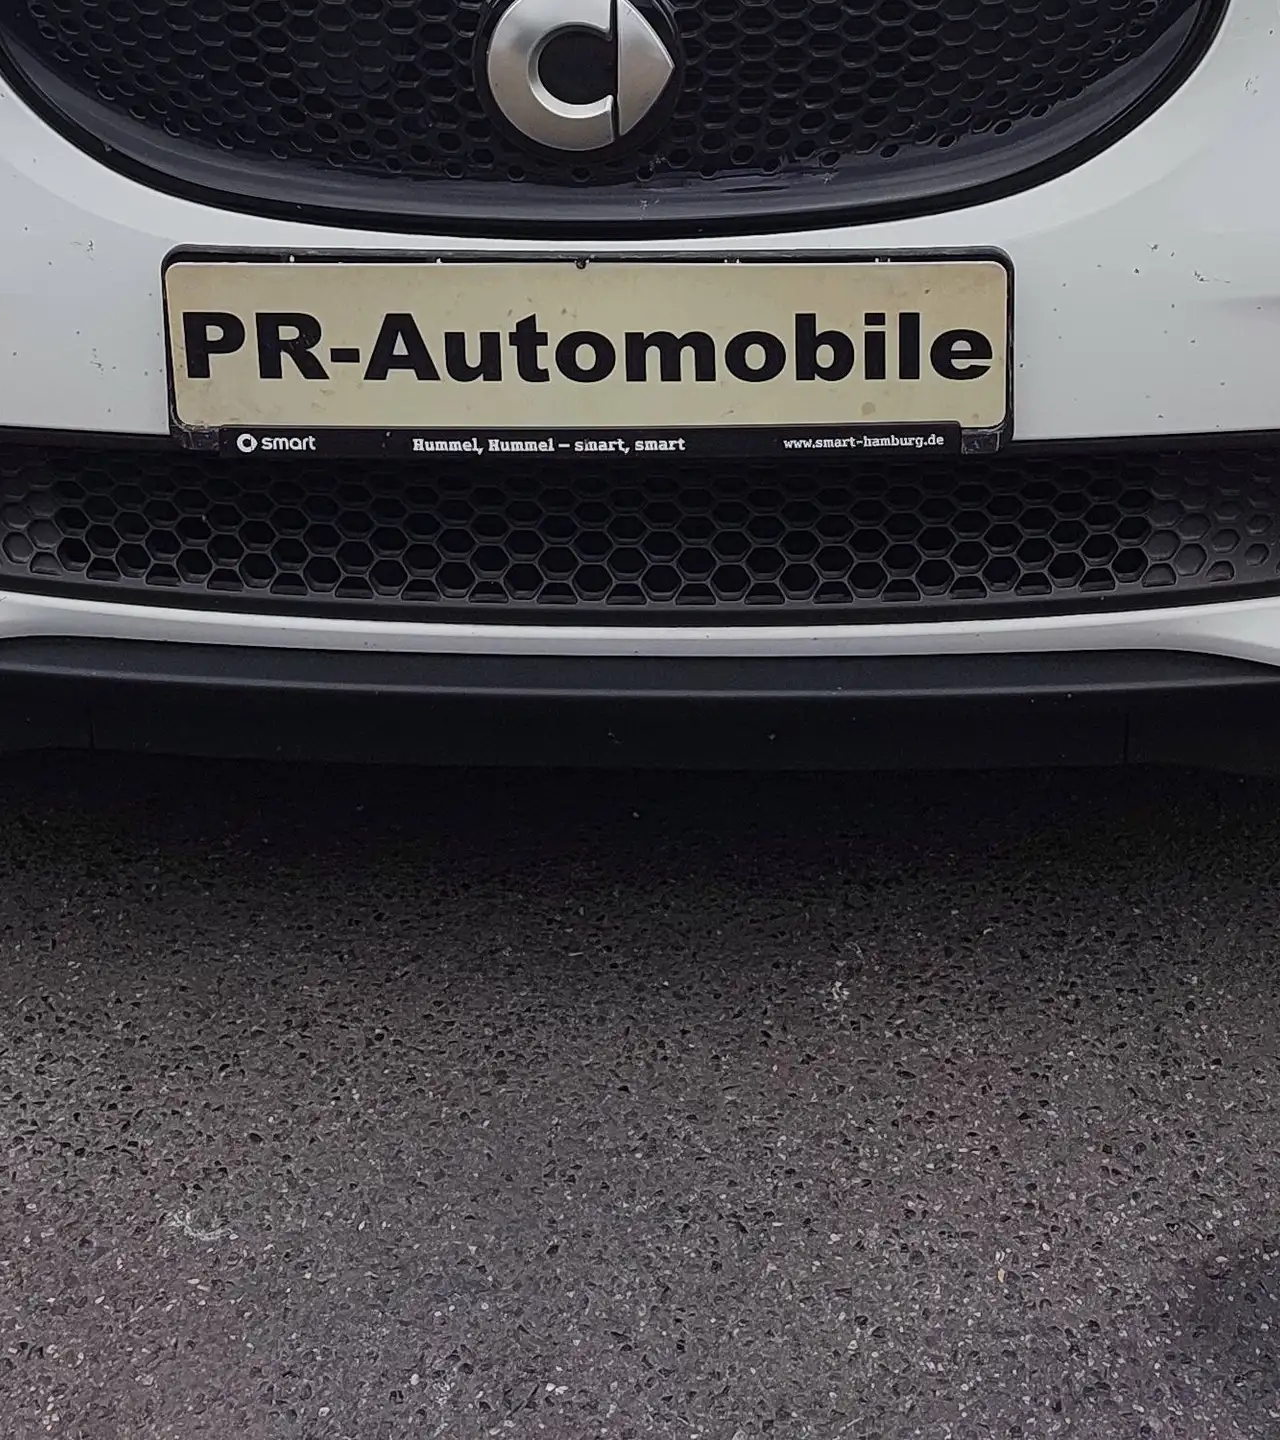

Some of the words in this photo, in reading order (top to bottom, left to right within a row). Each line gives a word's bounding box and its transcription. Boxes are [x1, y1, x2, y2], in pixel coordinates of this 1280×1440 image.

[182, 312, 993, 383] PR-Automobile
[261, 435, 317, 451] smart
[412, 437, 484, 455] Hummel,
[488, 437, 555, 452] Hummel
[574, 438, 630, 455] smart,
[634, 437, 686, 452] smart
[783, 433, 945, 450] www.smart-hamburg.de
